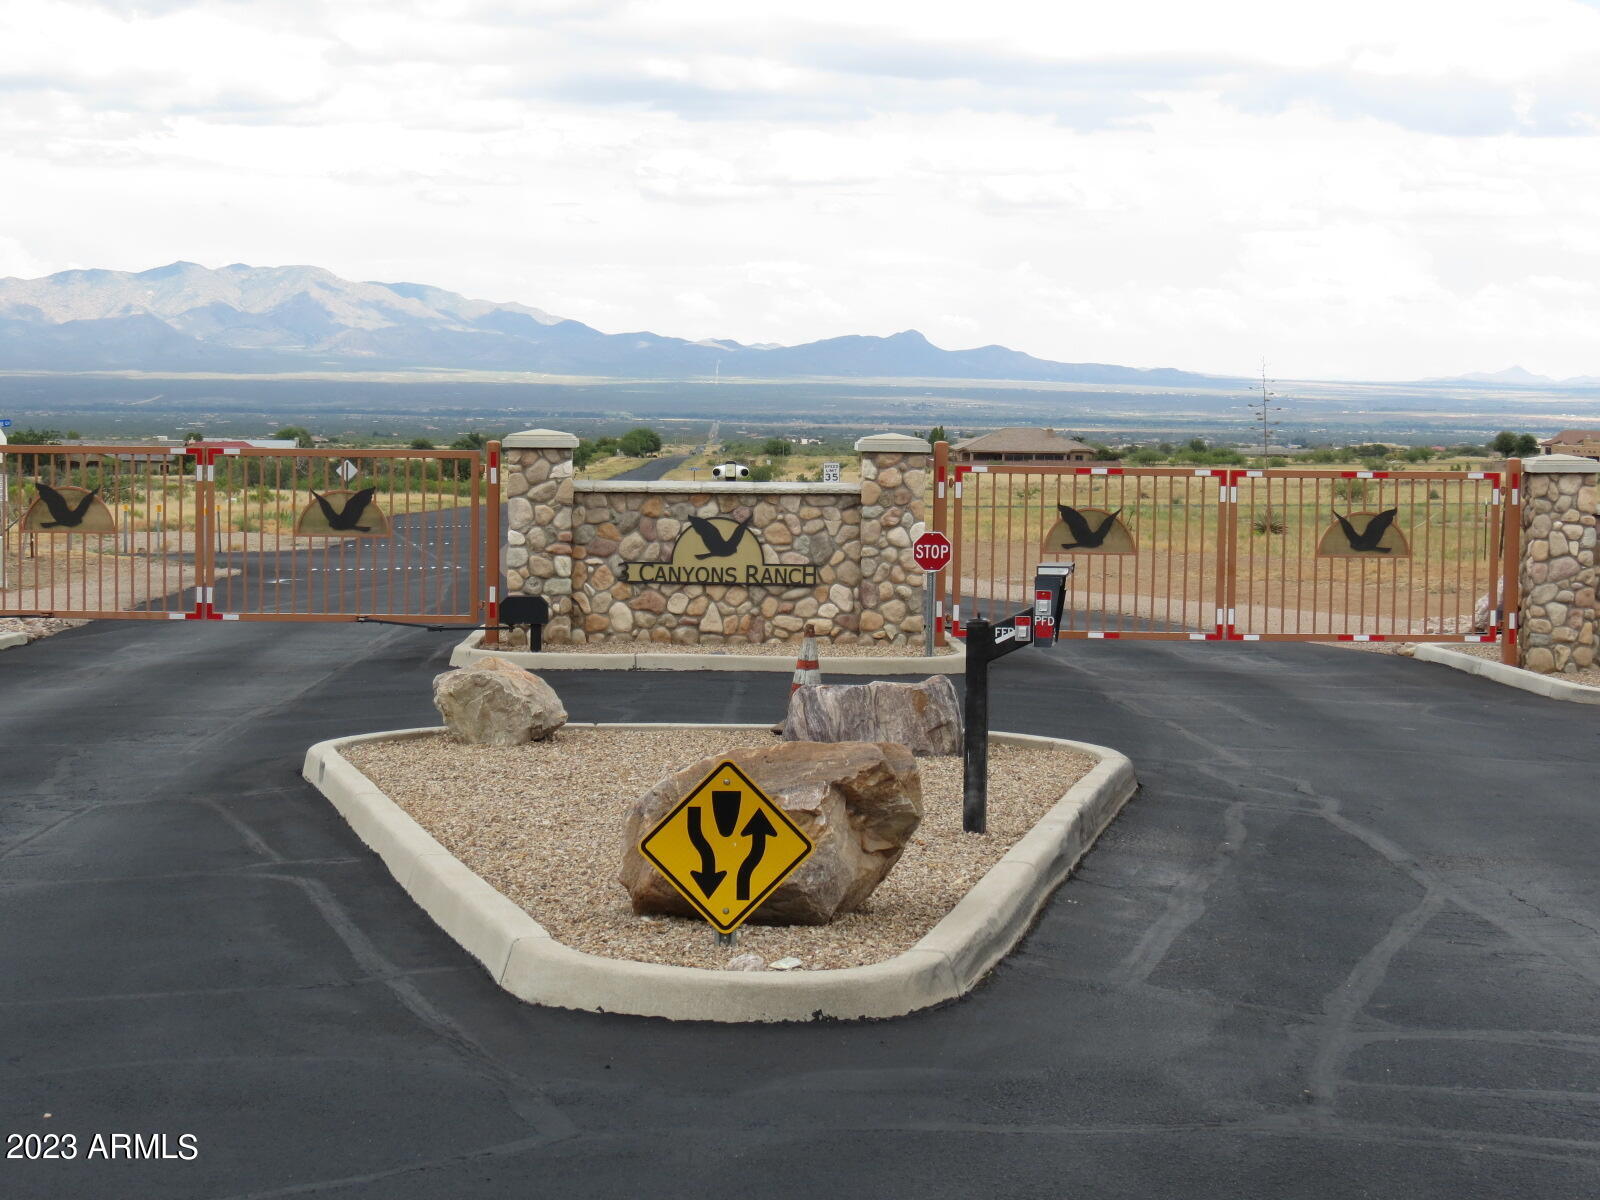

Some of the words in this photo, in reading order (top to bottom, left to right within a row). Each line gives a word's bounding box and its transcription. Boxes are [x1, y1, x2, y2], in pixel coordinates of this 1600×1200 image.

[825, 473, 839, 482] 35
[915, 544, 949, 559] STOP
[617, 562, 630, 582] 3
[639, 563, 738, 584] CANYONS
[746, 564, 817, 585] RANCH
[1034, 615, 1055, 626] PFD
